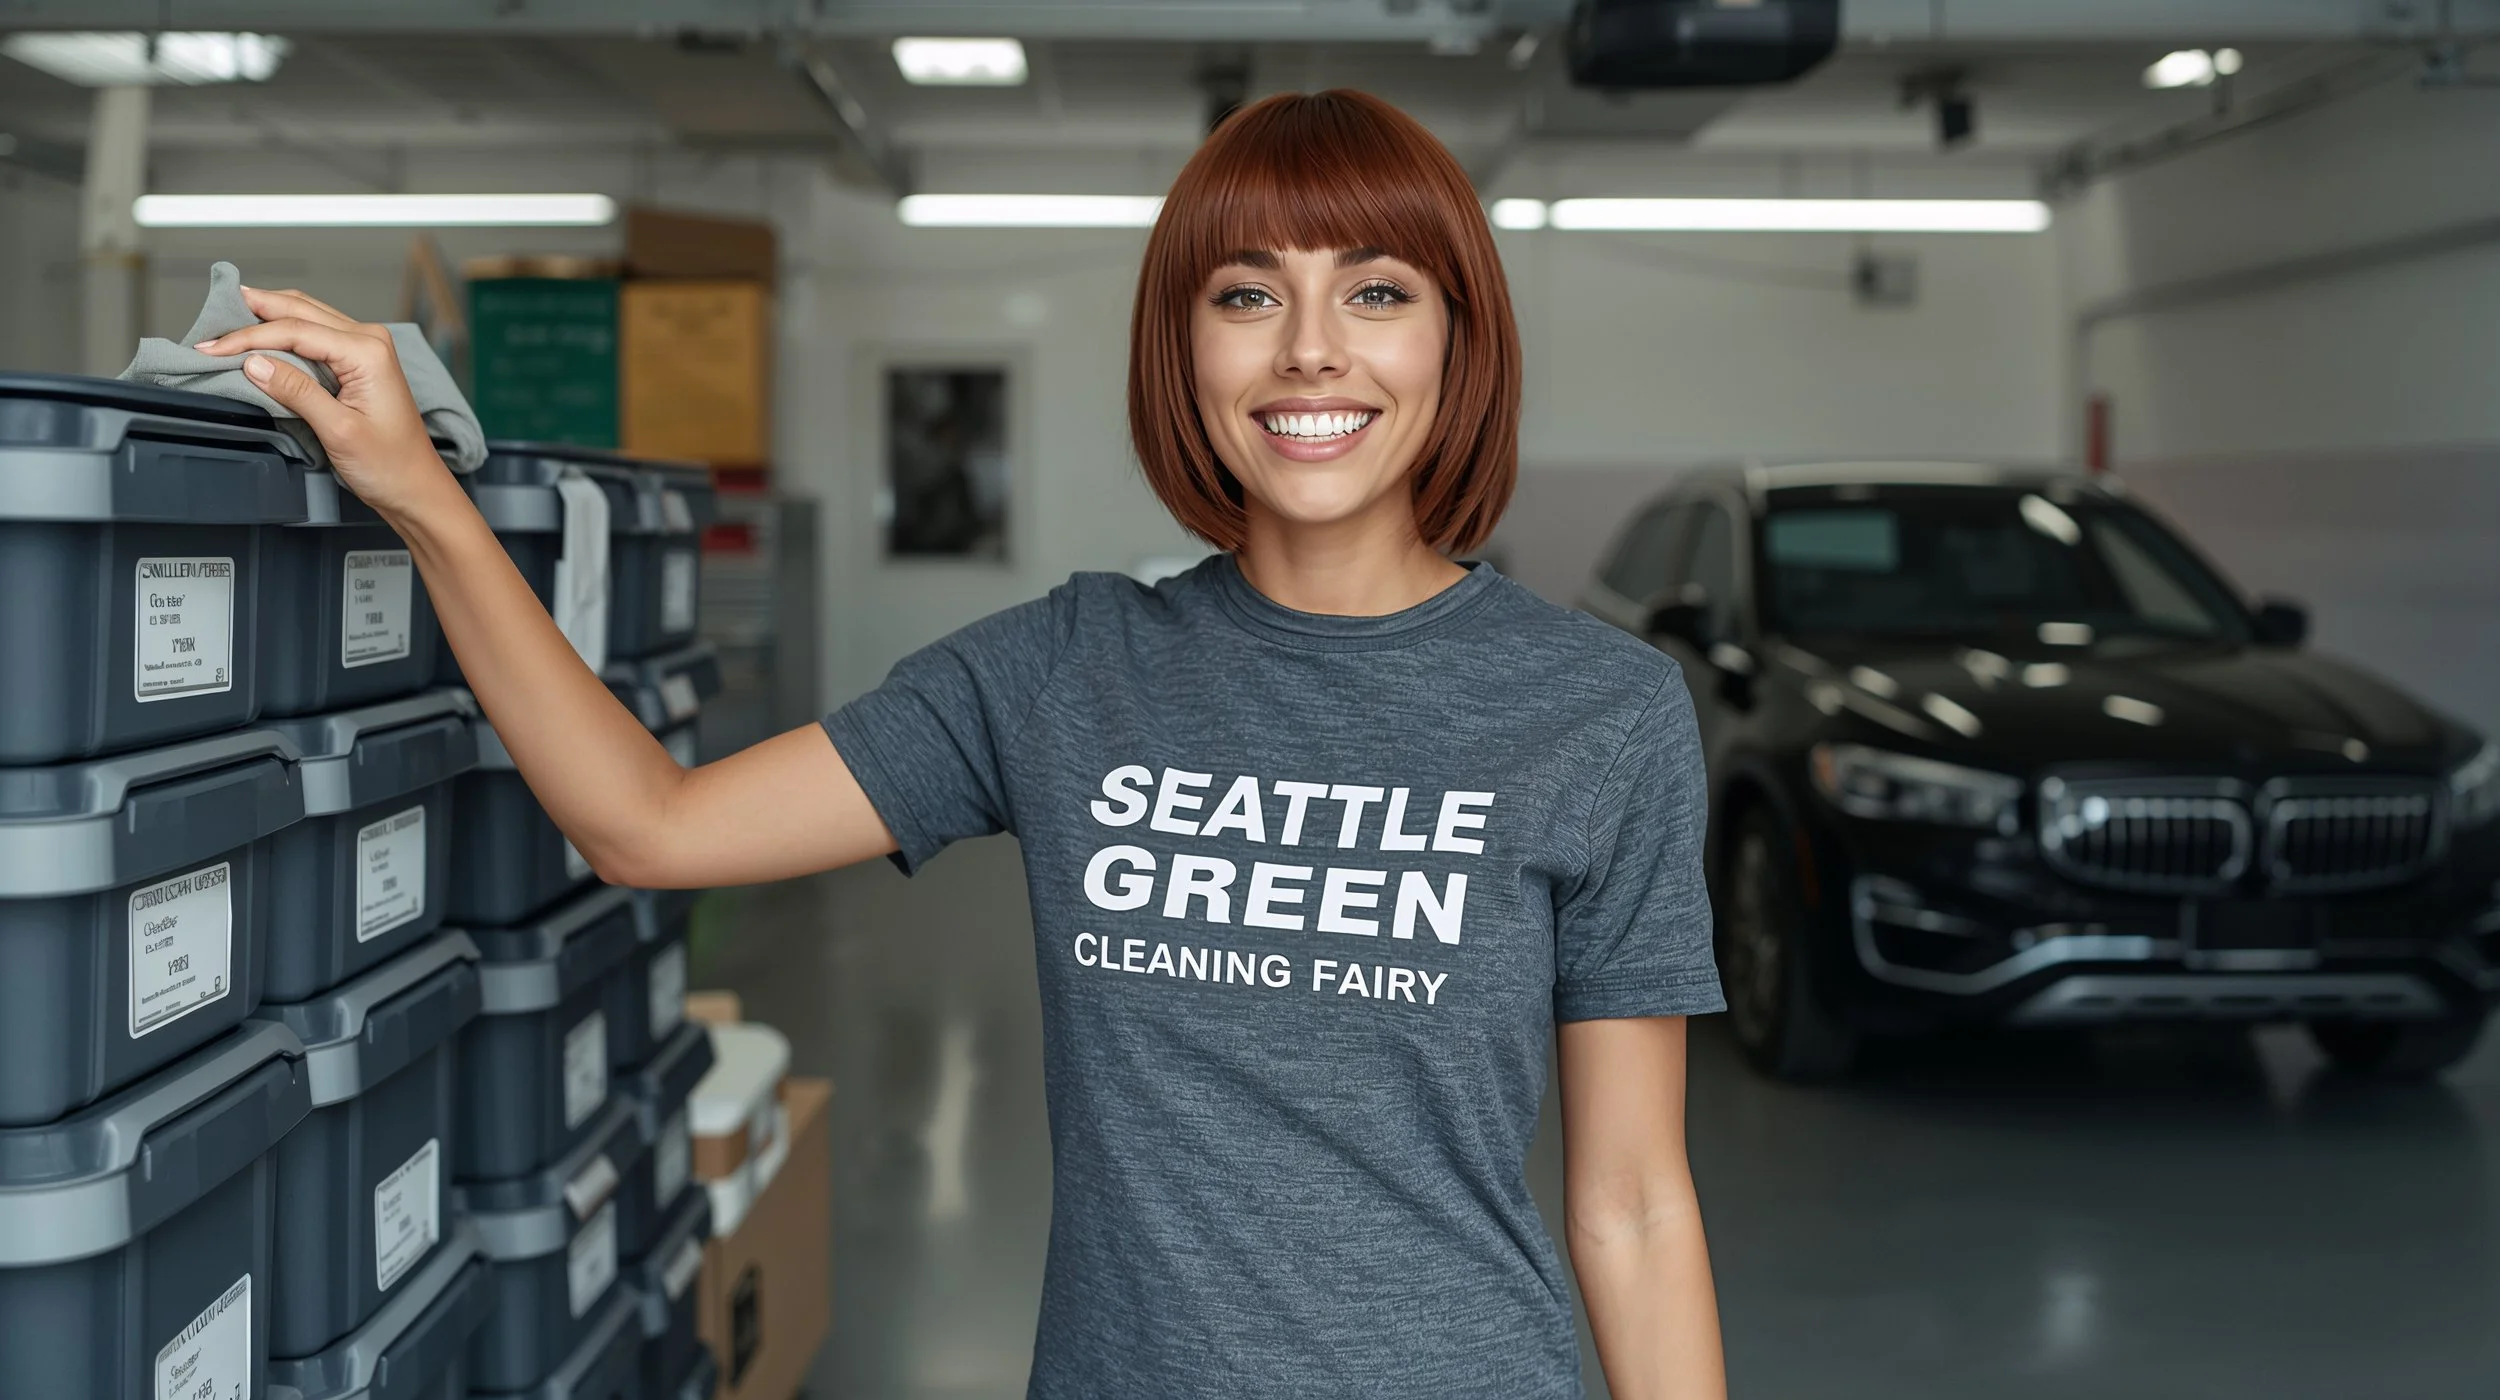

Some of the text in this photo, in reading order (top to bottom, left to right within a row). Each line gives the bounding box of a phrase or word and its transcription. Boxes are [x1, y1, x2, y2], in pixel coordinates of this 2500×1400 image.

[1090, 764, 1496, 855] SEATTLE
[1083, 845, 1468, 945] GREEN
[1074, 932, 1449, 1005] CLEANING FAIRY
